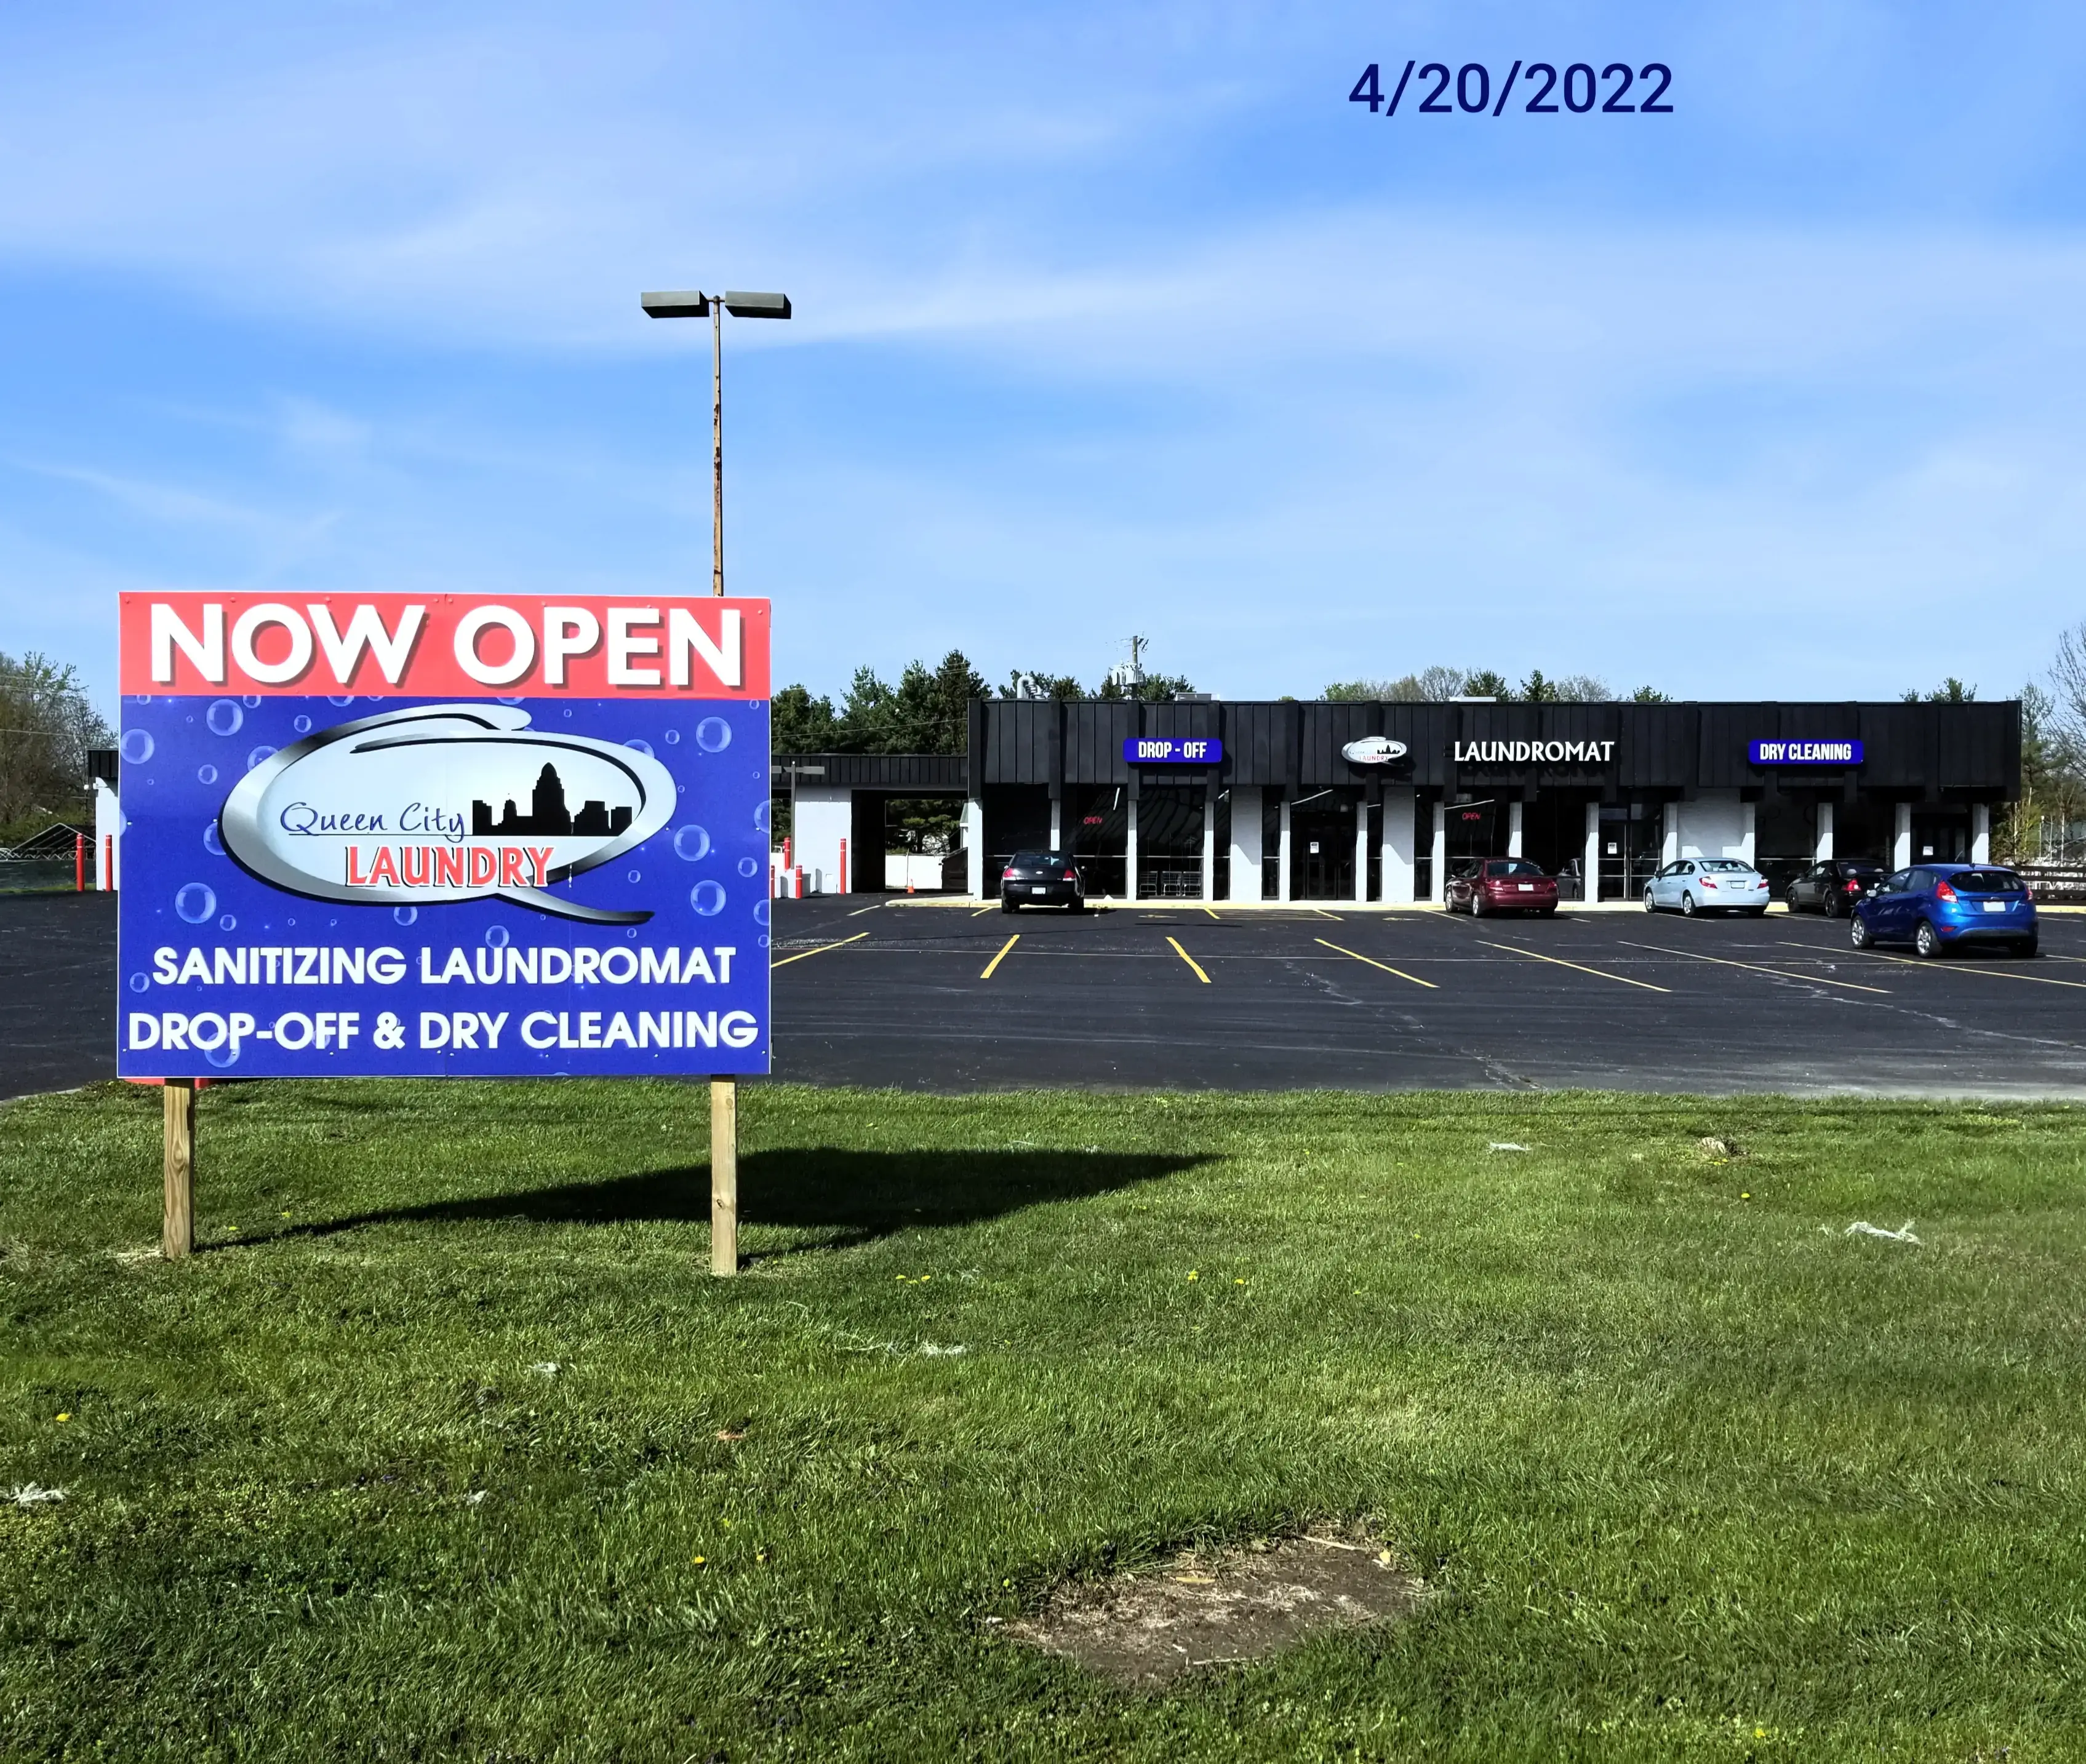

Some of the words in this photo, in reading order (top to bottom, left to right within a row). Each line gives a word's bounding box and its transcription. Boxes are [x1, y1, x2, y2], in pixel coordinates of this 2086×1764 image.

[151, 603, 425, 684] NOW
[453, 605, 741, 686] OPEN
[1138, 741, 1172, 758] DROP
[1183, 742, 1207, 758] OFF
[1454, 741, 1615, 761] LAUNDROMAT
[1760, 743, 1786, 760] DRY
[1788, 743, 1852, 760] CLEANING
[281, 802, 388, 836] Queen
[399, 802, 465, 843] City
[1084, 816, 1103, 824] OPEN
[345, 845, 555, 888] LAUNDRY
[152, 946, 407, 984] SANITIZING
[420, 946, 737, 984] LAUNDROMAT
[129, 1012, 360, 1050] DROP-OFF
[373, 1011, 406, 1050] &
[420, 1012, 510, 1049] DRY
[521, 1010, 759, 1050] CLEANING
